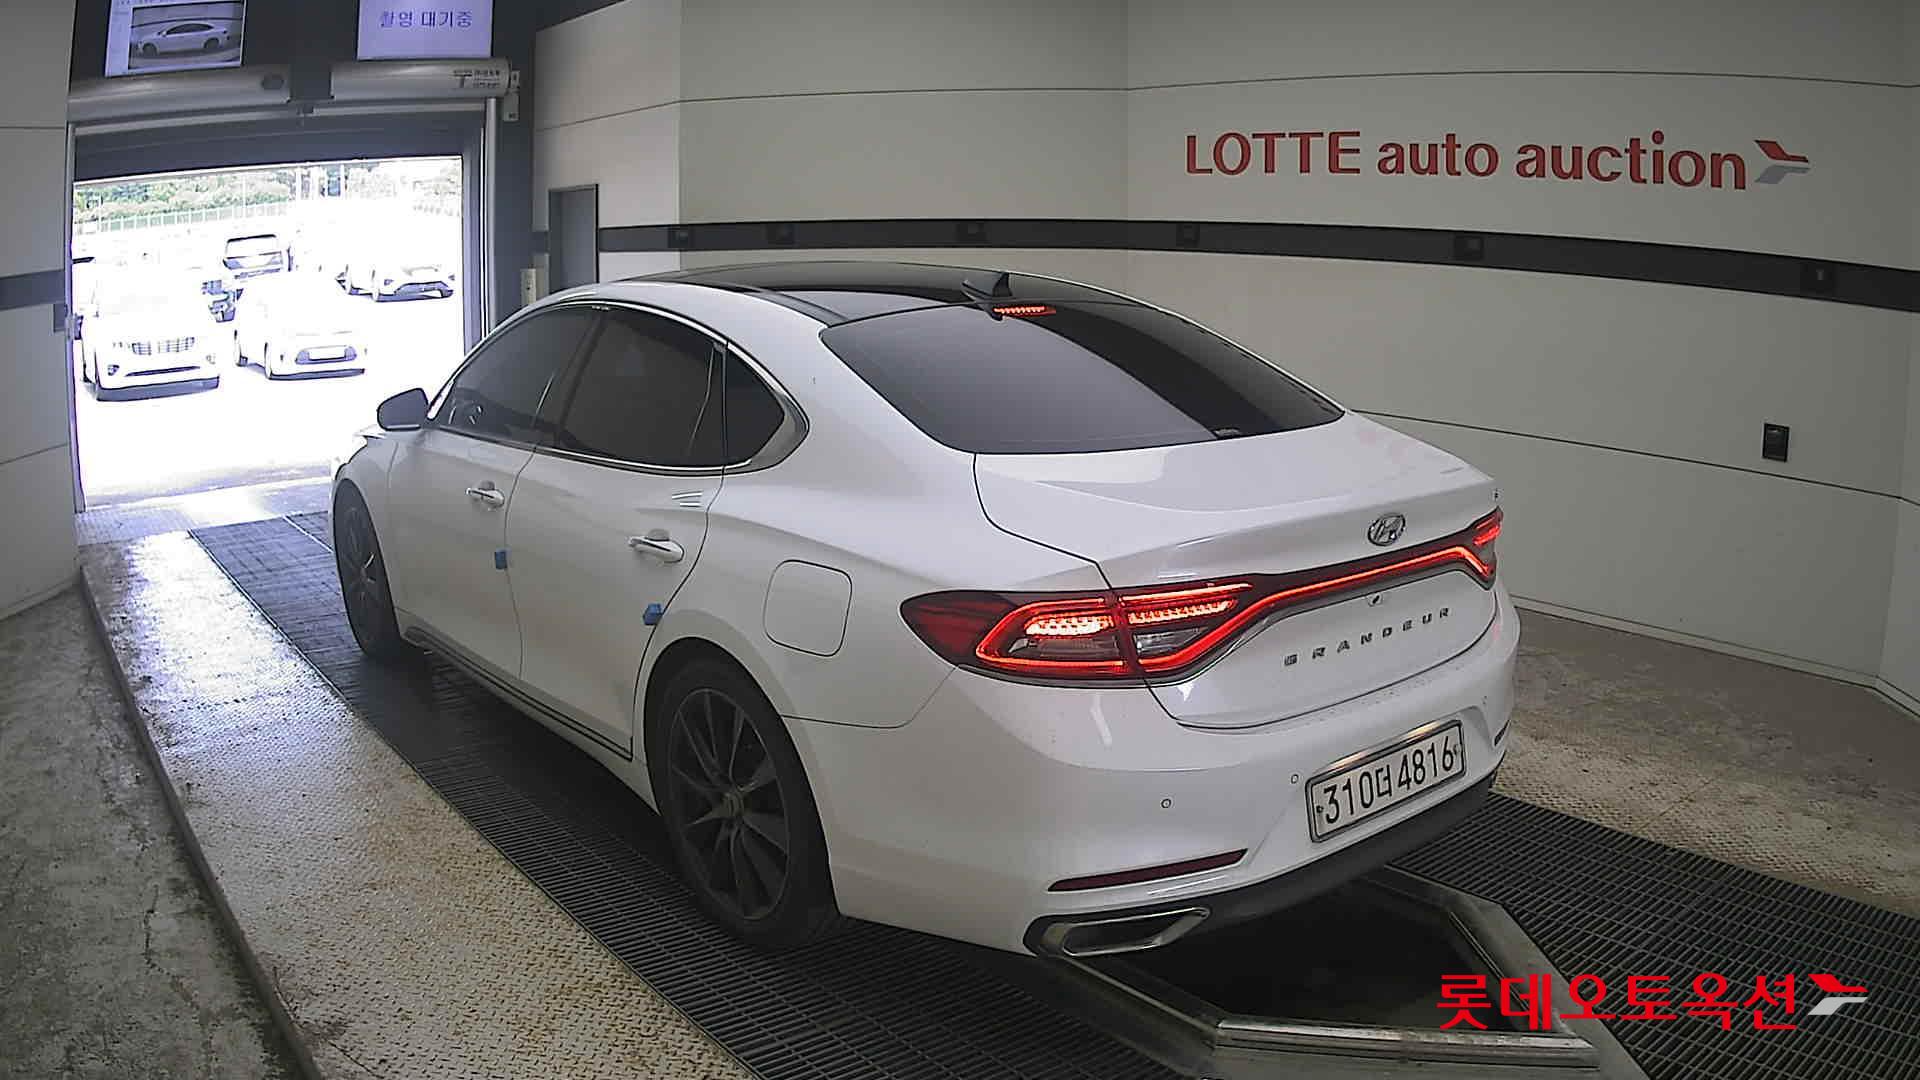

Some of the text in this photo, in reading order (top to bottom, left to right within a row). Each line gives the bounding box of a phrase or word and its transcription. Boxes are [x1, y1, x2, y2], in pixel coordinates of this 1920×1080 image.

[421, 10, 473, 28] 대기중
[1185, 130, 1746, 190] LOTTE auto auction
[1283, 606, 1451, 667] GRANDEUR
[1397, 735, 1454, 791] 4816
